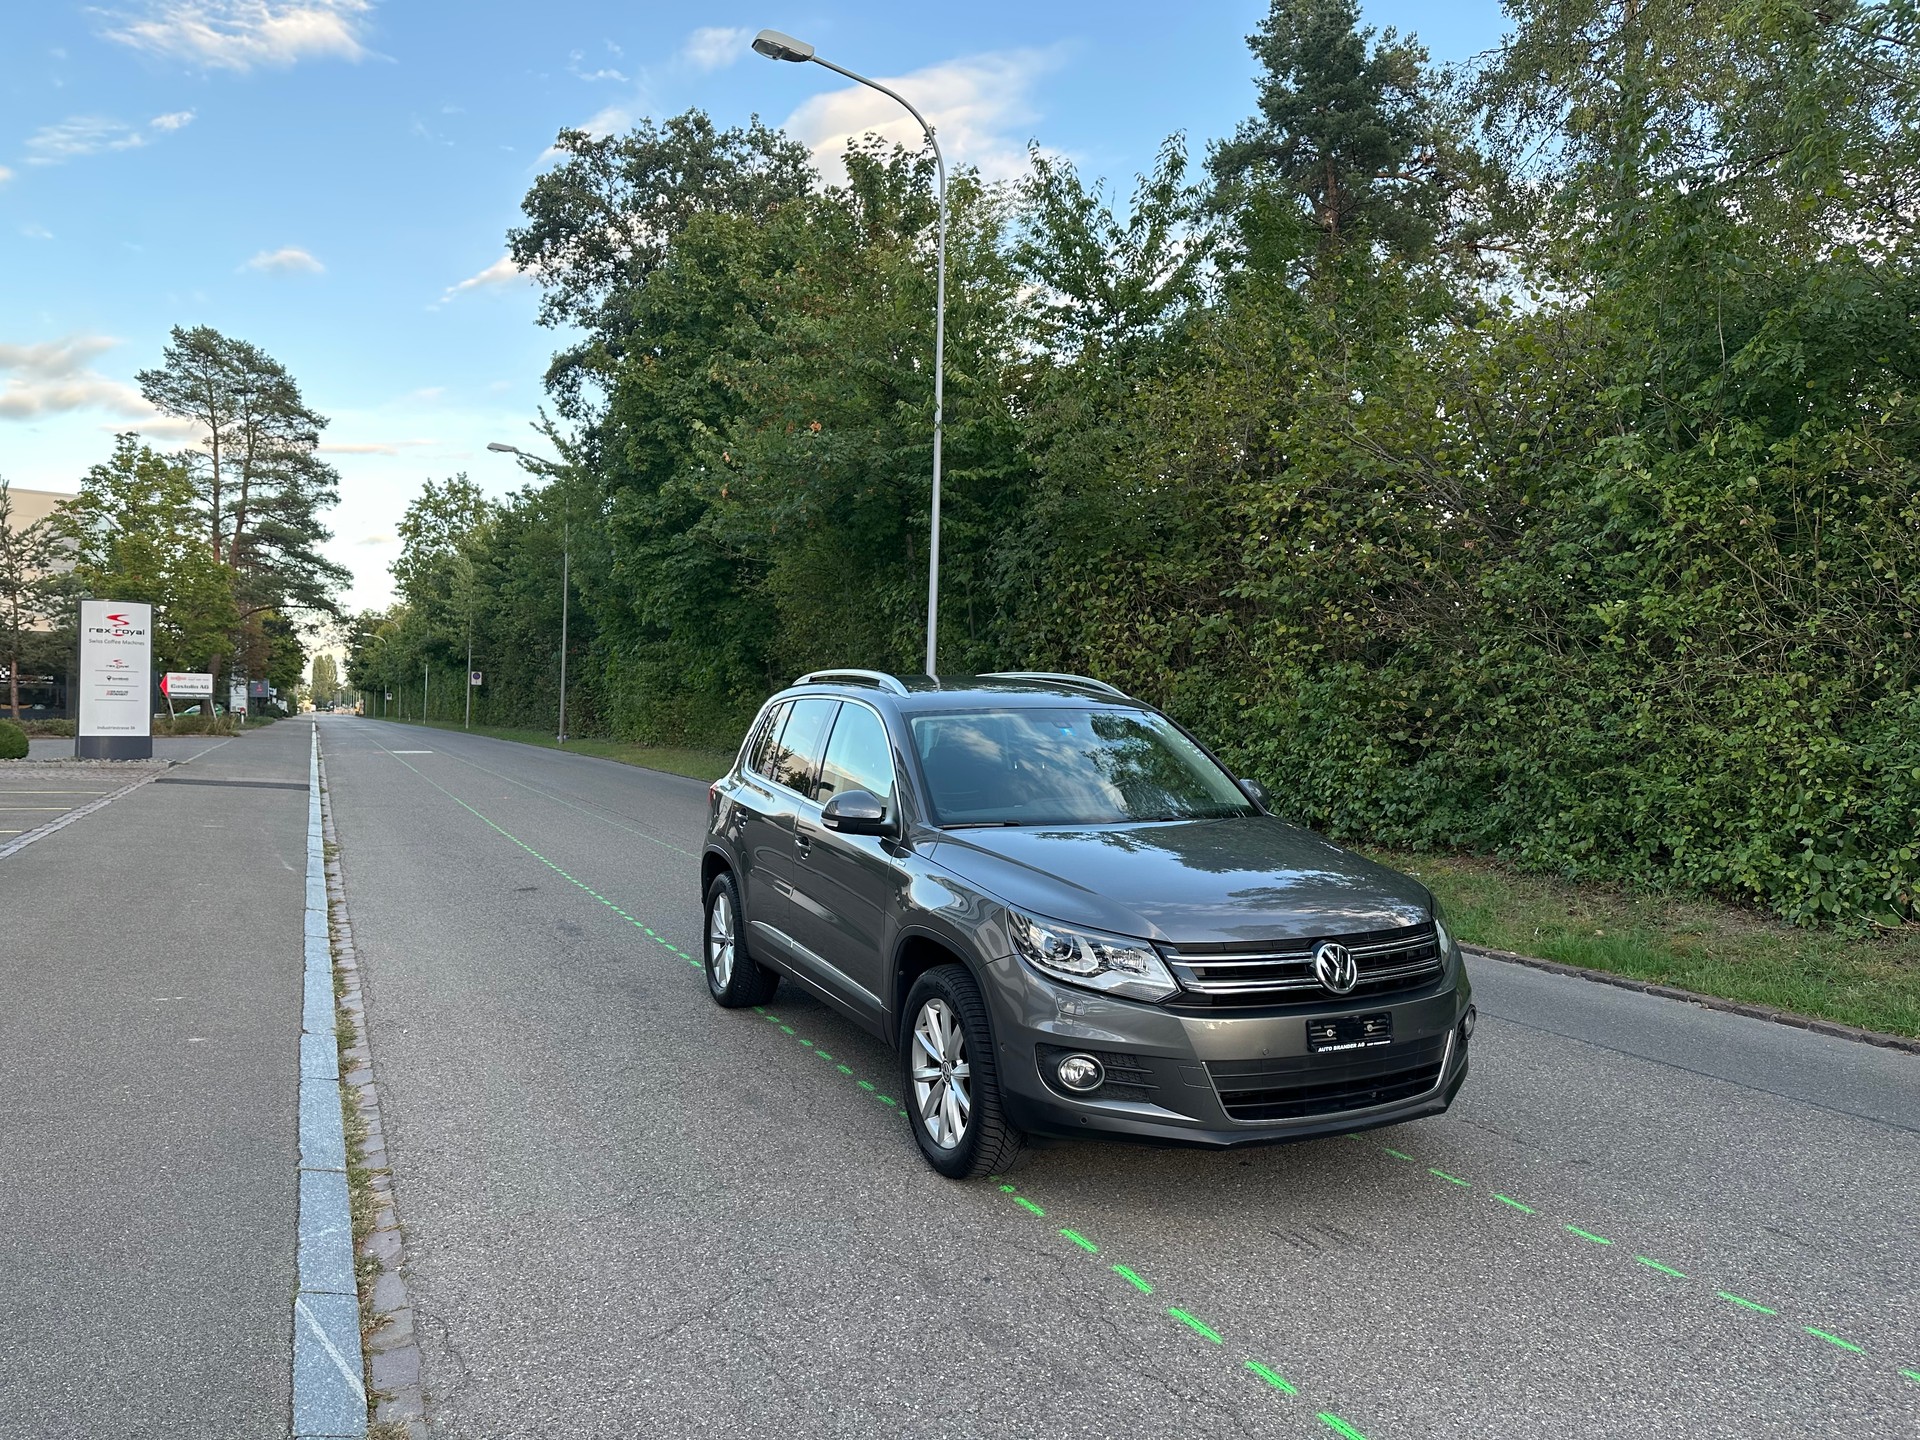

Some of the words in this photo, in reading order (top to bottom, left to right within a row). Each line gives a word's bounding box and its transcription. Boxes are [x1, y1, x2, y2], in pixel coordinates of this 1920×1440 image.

[115, 628, 145, 636] royal
[1317, 1045, 1333, 1053] AUTO
[1333, 1043, 1357, 1051] BRANDER
